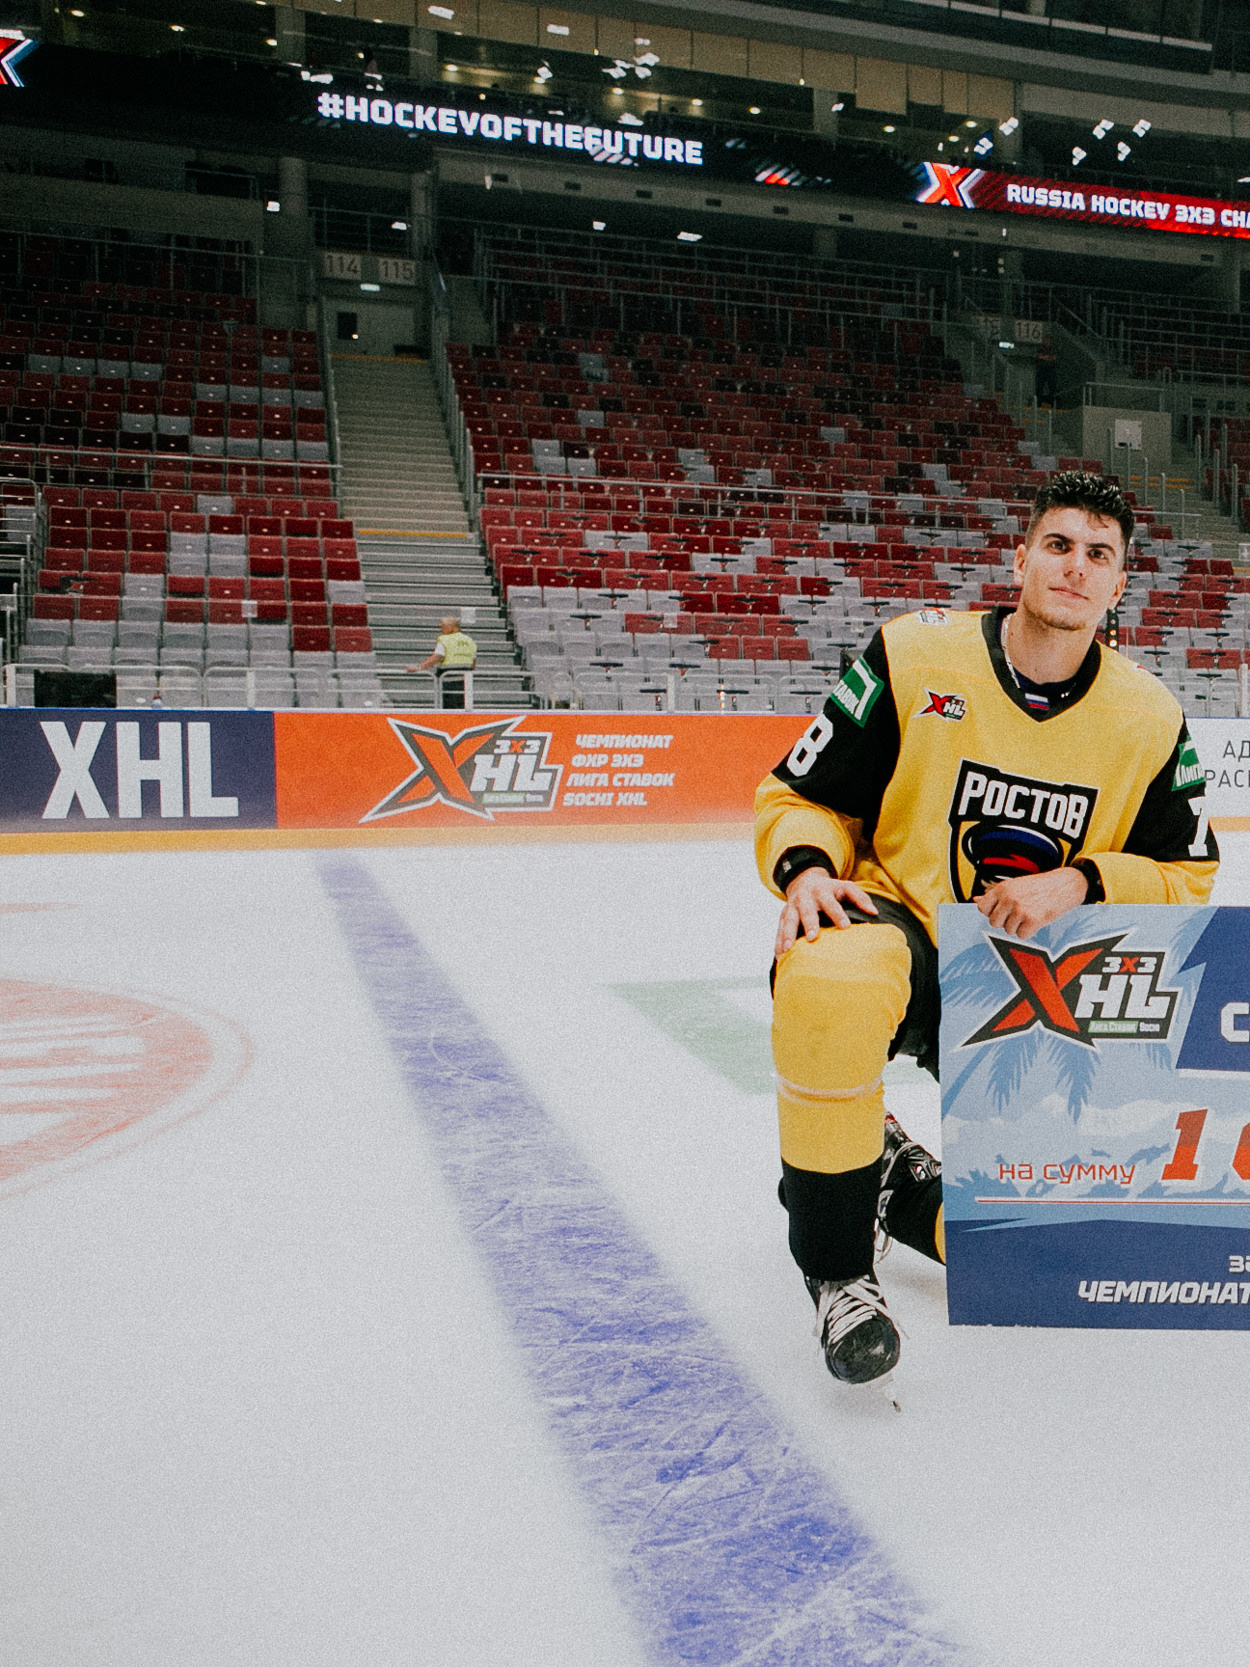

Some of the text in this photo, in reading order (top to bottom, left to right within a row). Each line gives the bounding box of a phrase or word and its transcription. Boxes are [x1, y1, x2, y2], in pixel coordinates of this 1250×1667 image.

[318, 93, 703, 164] #HOCKEYOFTHEFUTURE
[1007, 184, 1085, 211] RUSSIA
[1091, 195, 1171, 220] HOCKEY
[1176, 205, 1215, 225] 3X3
[327, 255, 358, 277] 114
[381, 261, 414, 283] 115
[1017, 322, 1041, 340] 116
[920, 691, 965, 719] XHL
[576, 734, 674, 748] ЧЕМПИОНАТ
[787, 712, 834, 777] 8
[39, 721, 240, 820] XHL
[376, 724, 554, 812] XHL
[571, 755, 607, 768] ФХР
[566, 773, 674, 787] ЛИГА СТАВОК
[563, 793, 648, 806] SOCHI XHL
[957, 772, 1089, 839] РОСТОВ
[1102, 957, 1157, 973] 3X3
[976, 939, 1172, 1040] XHL
[999, 1162, 1034, 1180] на
[1043, 1163, 1136, 1184] сумму
[1161, 1108, 1208, 1180] 1
